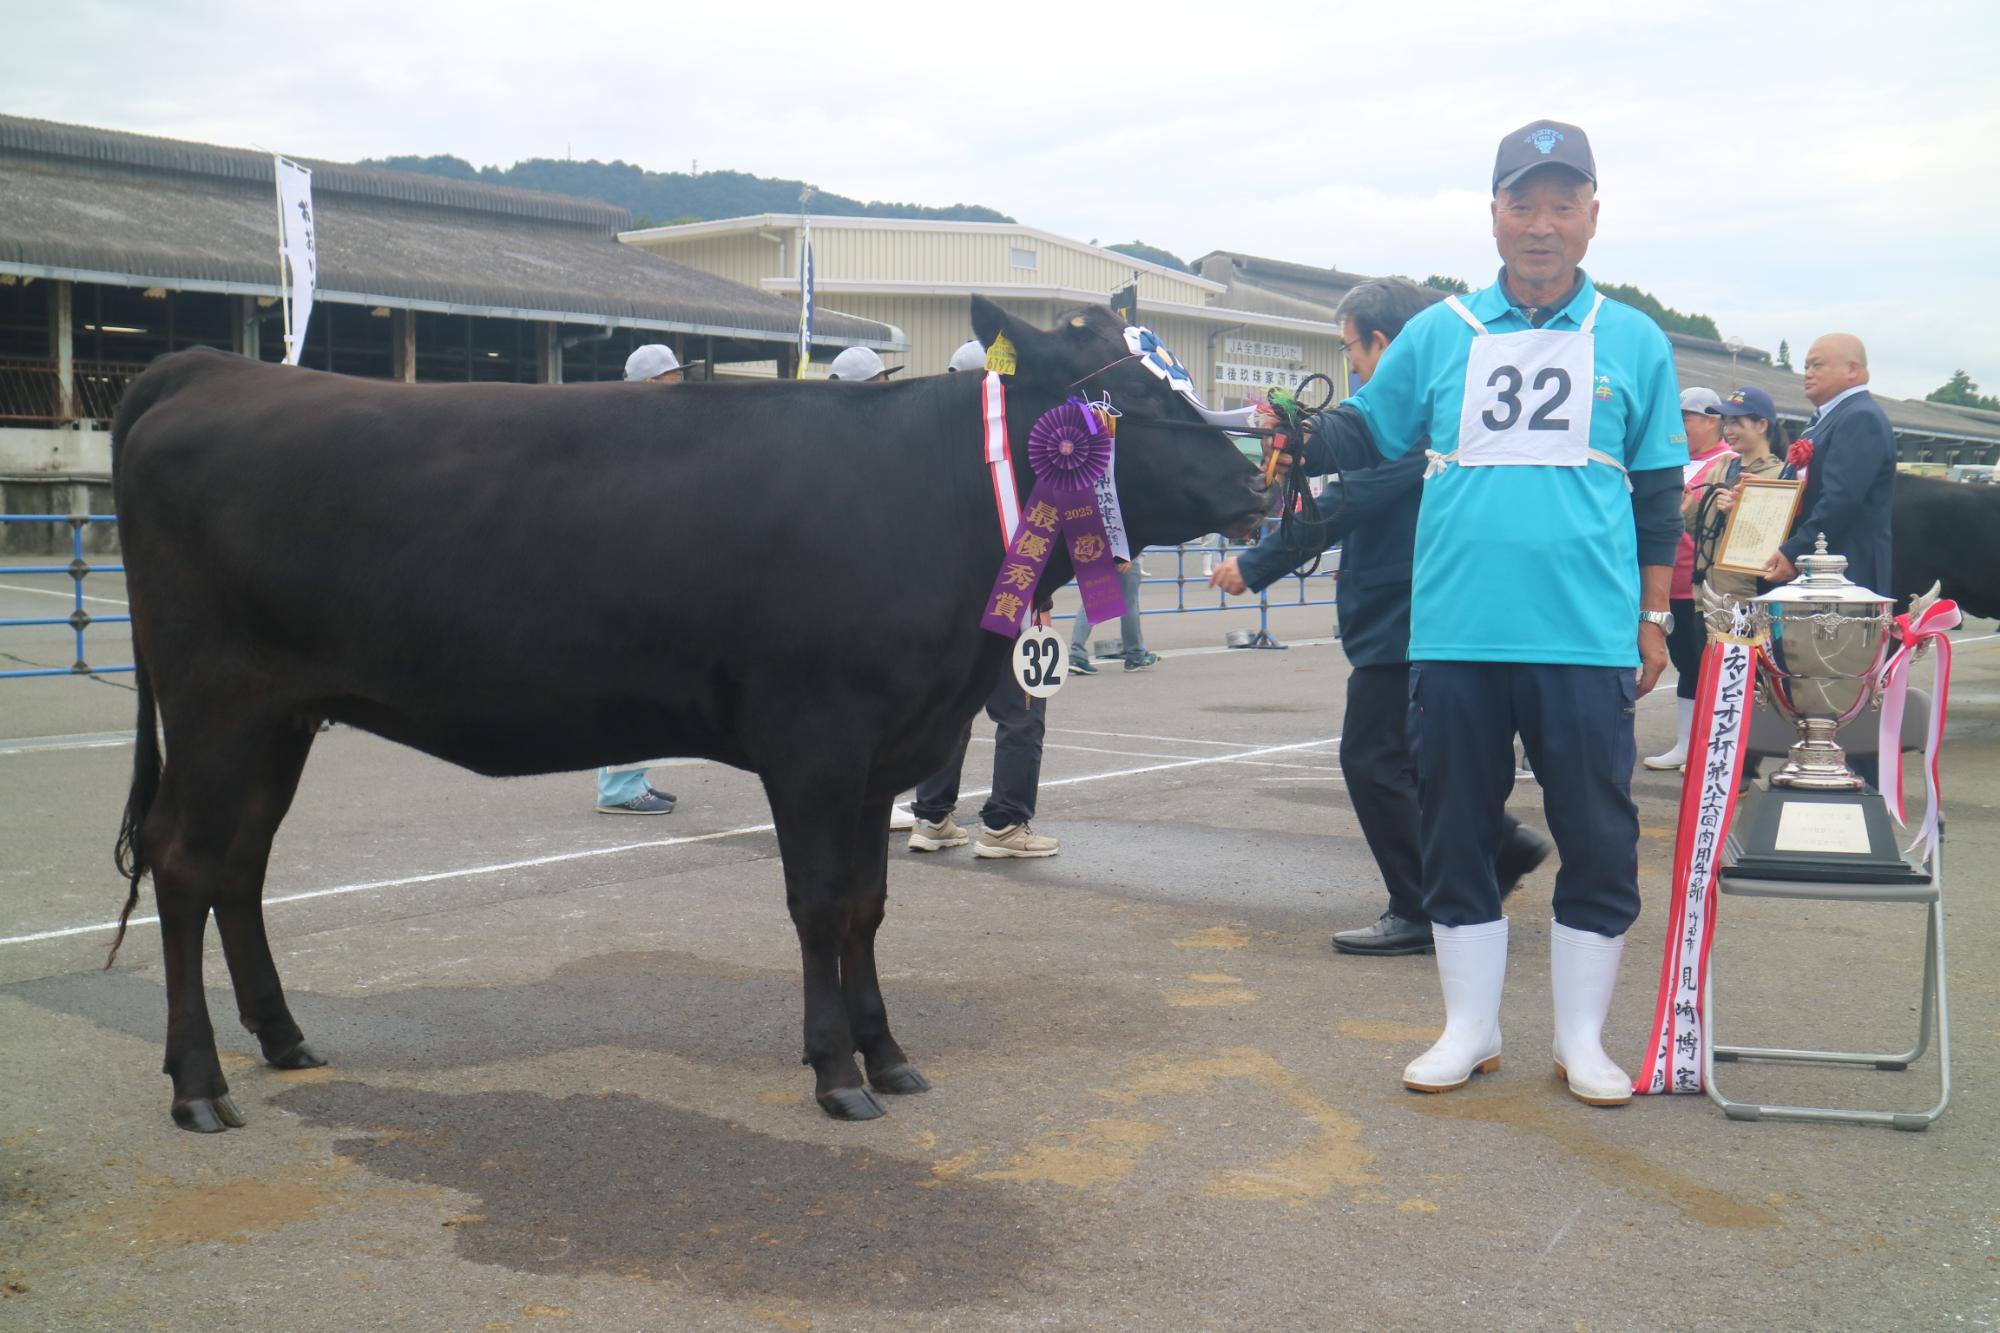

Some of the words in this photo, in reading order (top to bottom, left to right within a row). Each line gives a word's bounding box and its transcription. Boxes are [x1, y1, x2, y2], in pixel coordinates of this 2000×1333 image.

[1481, 364, 1572, 432] 32
[1064, 506, 1094, 521] 2025
[988, 500, 1059, 624] 最優秀賞
[1022, 637, 1061, 688] 32
